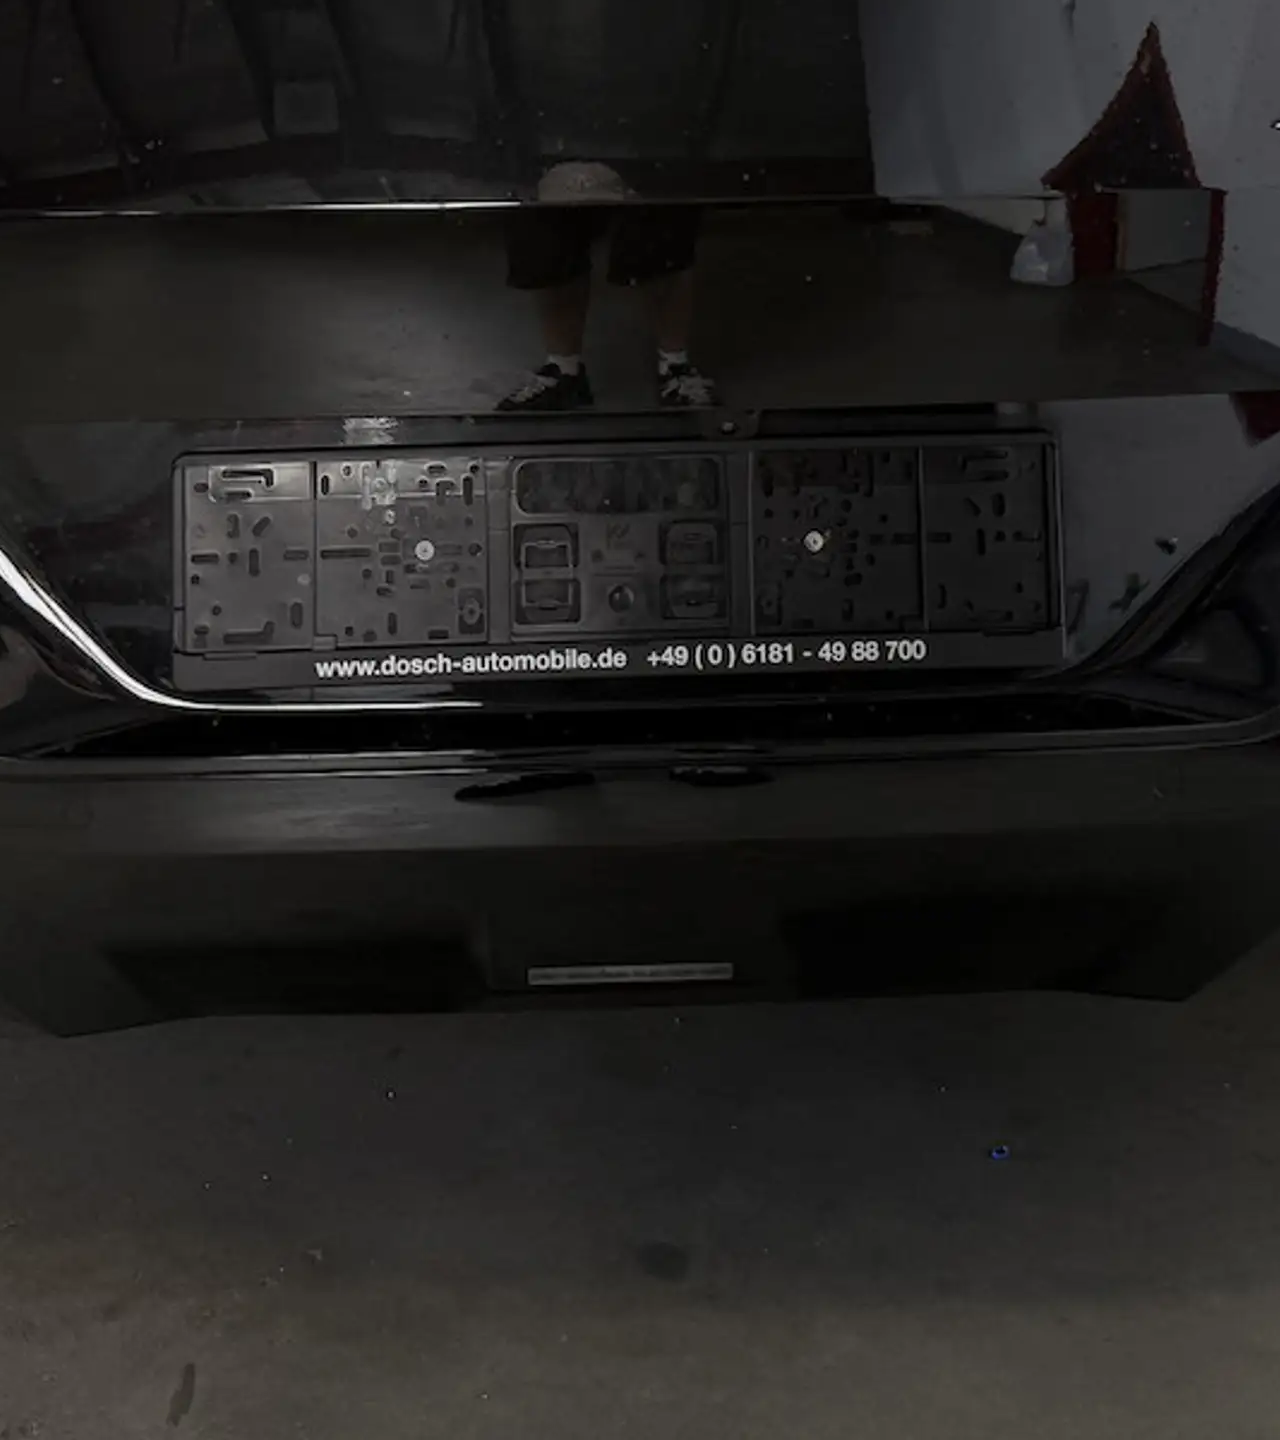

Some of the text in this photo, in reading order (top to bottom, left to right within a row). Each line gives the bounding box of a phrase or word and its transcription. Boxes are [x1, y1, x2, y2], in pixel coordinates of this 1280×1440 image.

[315, 647, 627, 678] www.dosch-automobile.de
[647, 645, 689, 667] +49
[741, 643, 794, 664] 6181
[818, 641, 846, 662] 49
[851, 640, 879, 661] 88
[885, 639, 926, 661] 700
